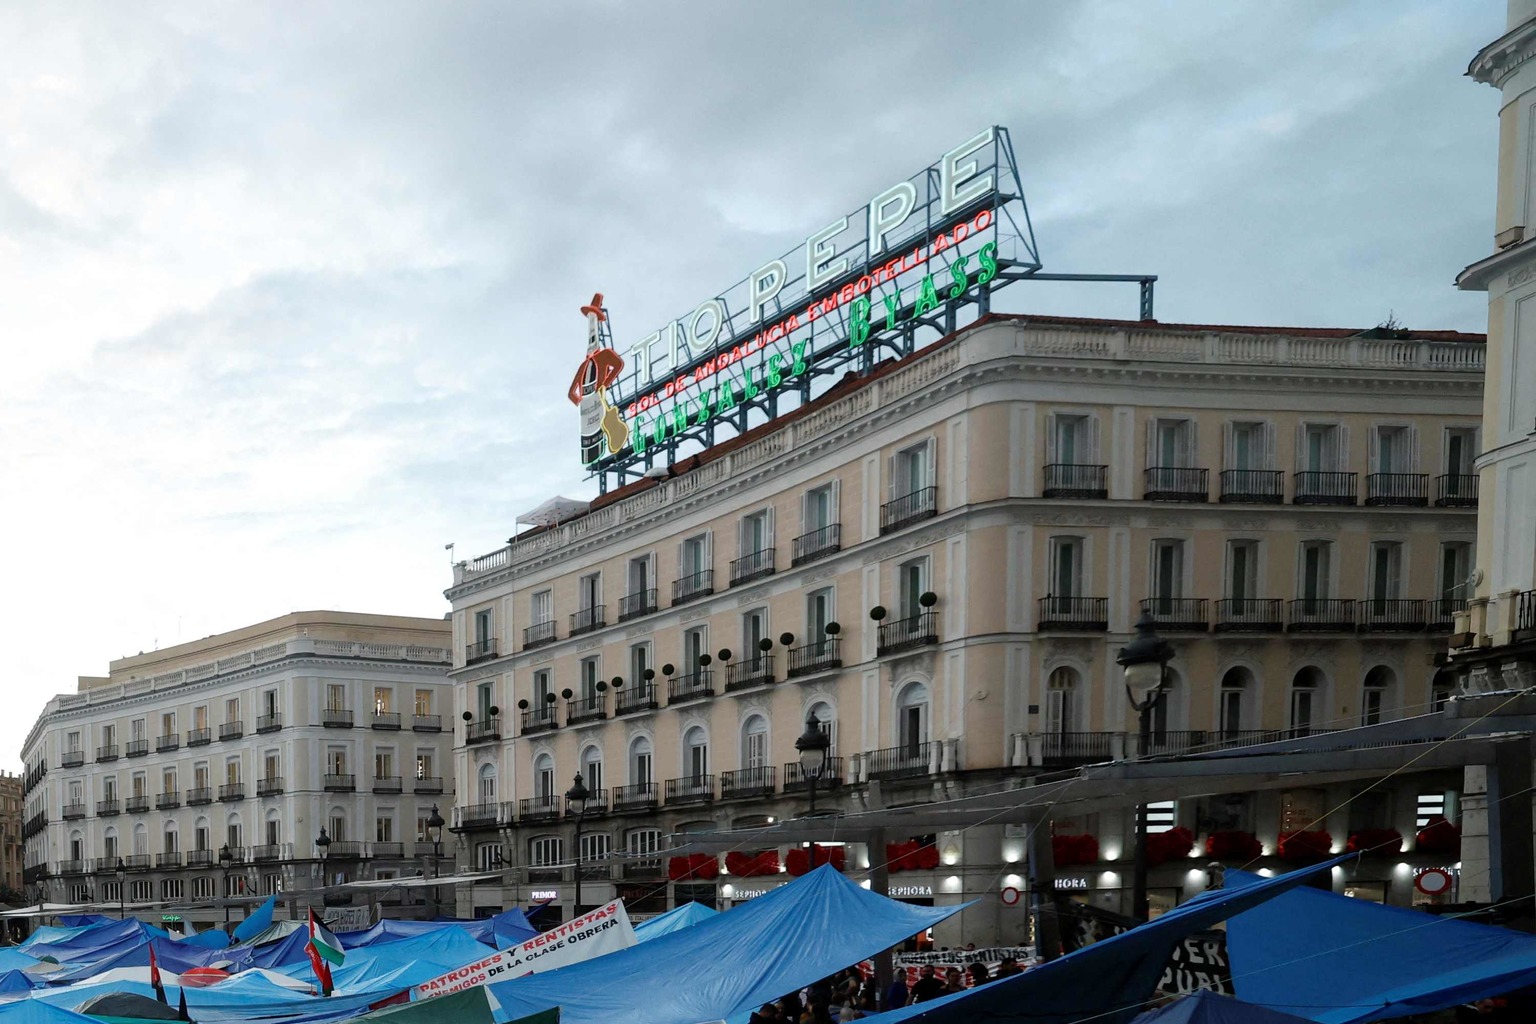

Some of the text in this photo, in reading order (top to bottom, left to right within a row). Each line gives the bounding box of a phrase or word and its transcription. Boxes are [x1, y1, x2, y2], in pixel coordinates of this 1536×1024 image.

[630, 125, 996, 385] TIO PEPE
[628, 209, 993, 418] SOL DE ANDALUCIA EMBOTELLADO
[632, 240, 998, 455] GONZALEZ BYASS
[531, 891, 557, 899] PRIMOR
[1054, 879, 1087, 889] HORA
[419, 903, 618, 993] PATRONES Y RENTISTAS
[488, 965, 504, 977] DE
[507, 959, 523, 969] LA
[525, 939, 565, 962] CLASE
[567, 918, 619, 944] OBRERA
